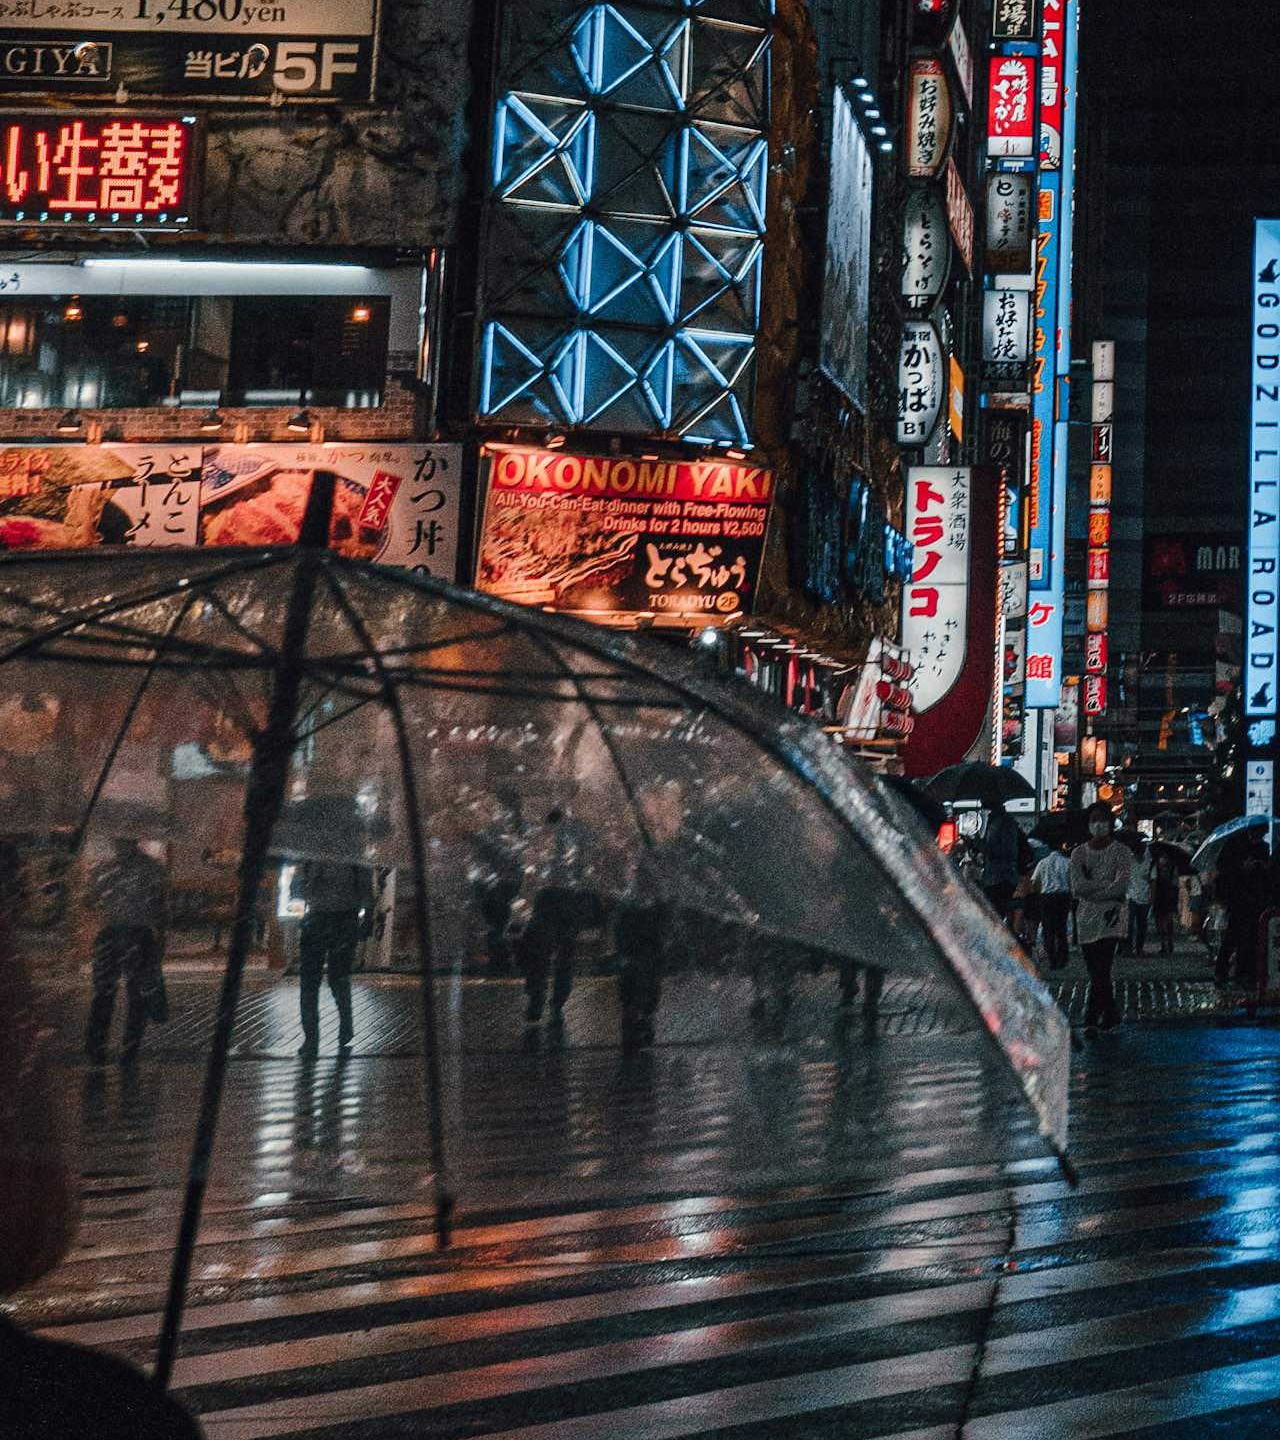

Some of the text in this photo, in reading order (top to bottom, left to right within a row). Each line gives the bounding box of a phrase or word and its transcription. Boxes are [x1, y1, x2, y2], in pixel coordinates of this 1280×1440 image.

[243, 5, 287, 25] yen
[1006, 25, 1021, 36] 5F
[272, 41, 360, 92] 5F
[916, 78, 937, 166] お好み焼き
[0, 121, 185, 210] い生蕎麦
[993, 292, 1020, 360] お好み焼
[903, 344, 932, 413] かっぱ
[903, 421, 927, 436] B1
[406, 451, 448, 556] かつ丼
[496, 457, 774, 500] OKONOMI YAKI
[1250, 293, 1280, 671] GODZILLA ROAD
[603, 516, 648, 533] Drinks
[649, 517, 669, 533] for
[670, 518, 680, 533] 2
[682, 518, 722, 535] hours
[607, 496, 650, 516] dinner
[651, 499, 681, 516] with
[683, 501, 768, 522] Free-Flowing
[947, 471, 968, 552] 大衆酒場
[909, 481, 944, 618] トラノコ
[649, 594, 737, 610] TORADYU 2F
